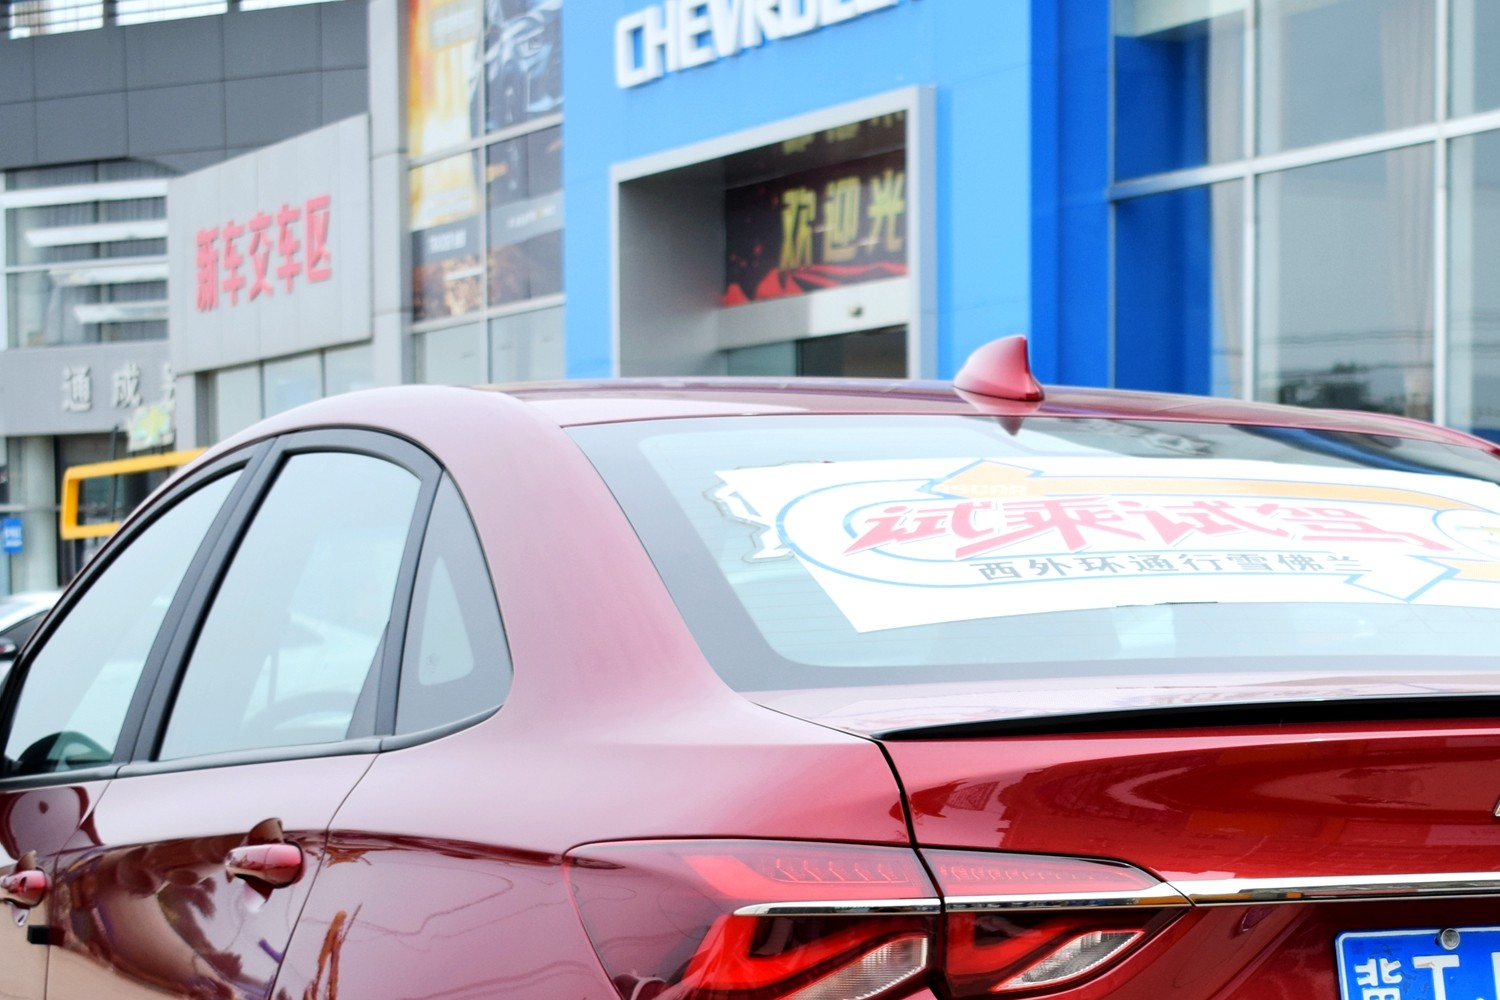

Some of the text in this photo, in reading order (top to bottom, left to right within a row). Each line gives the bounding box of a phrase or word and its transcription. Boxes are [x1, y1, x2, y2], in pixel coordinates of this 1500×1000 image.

[615, 0, 908, 89] CHEVR
[196, 194, 332, 312] 新车交车区
[842, 494, 1455, 560] 试乘试驾
[969, 550, 1373, 582] 西外环通行雪佛兰
